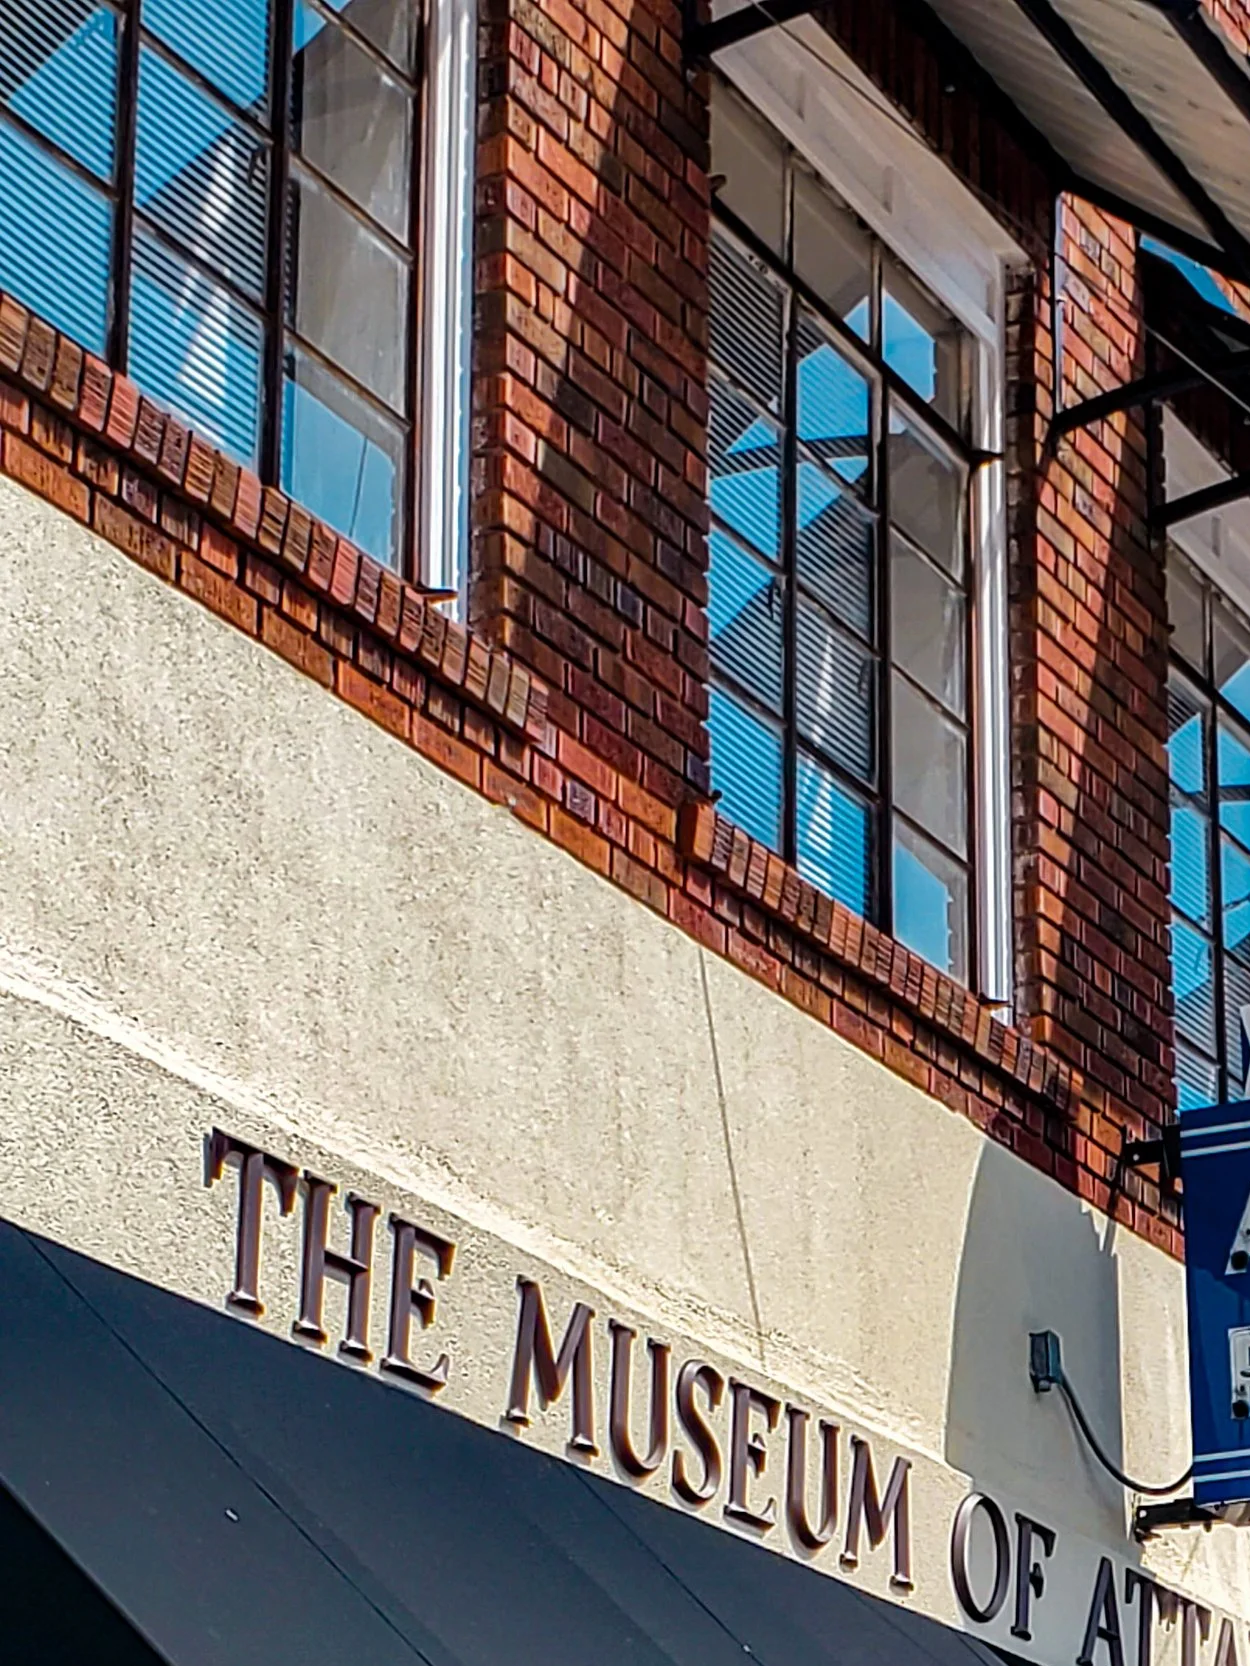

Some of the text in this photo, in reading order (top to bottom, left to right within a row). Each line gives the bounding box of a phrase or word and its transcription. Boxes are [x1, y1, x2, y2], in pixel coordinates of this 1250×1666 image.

[207, 1126, 455, 1390] THE
[500, 1275, 912, 1590] MUSEUM
[952, 1492, 1054, 1642] OF
